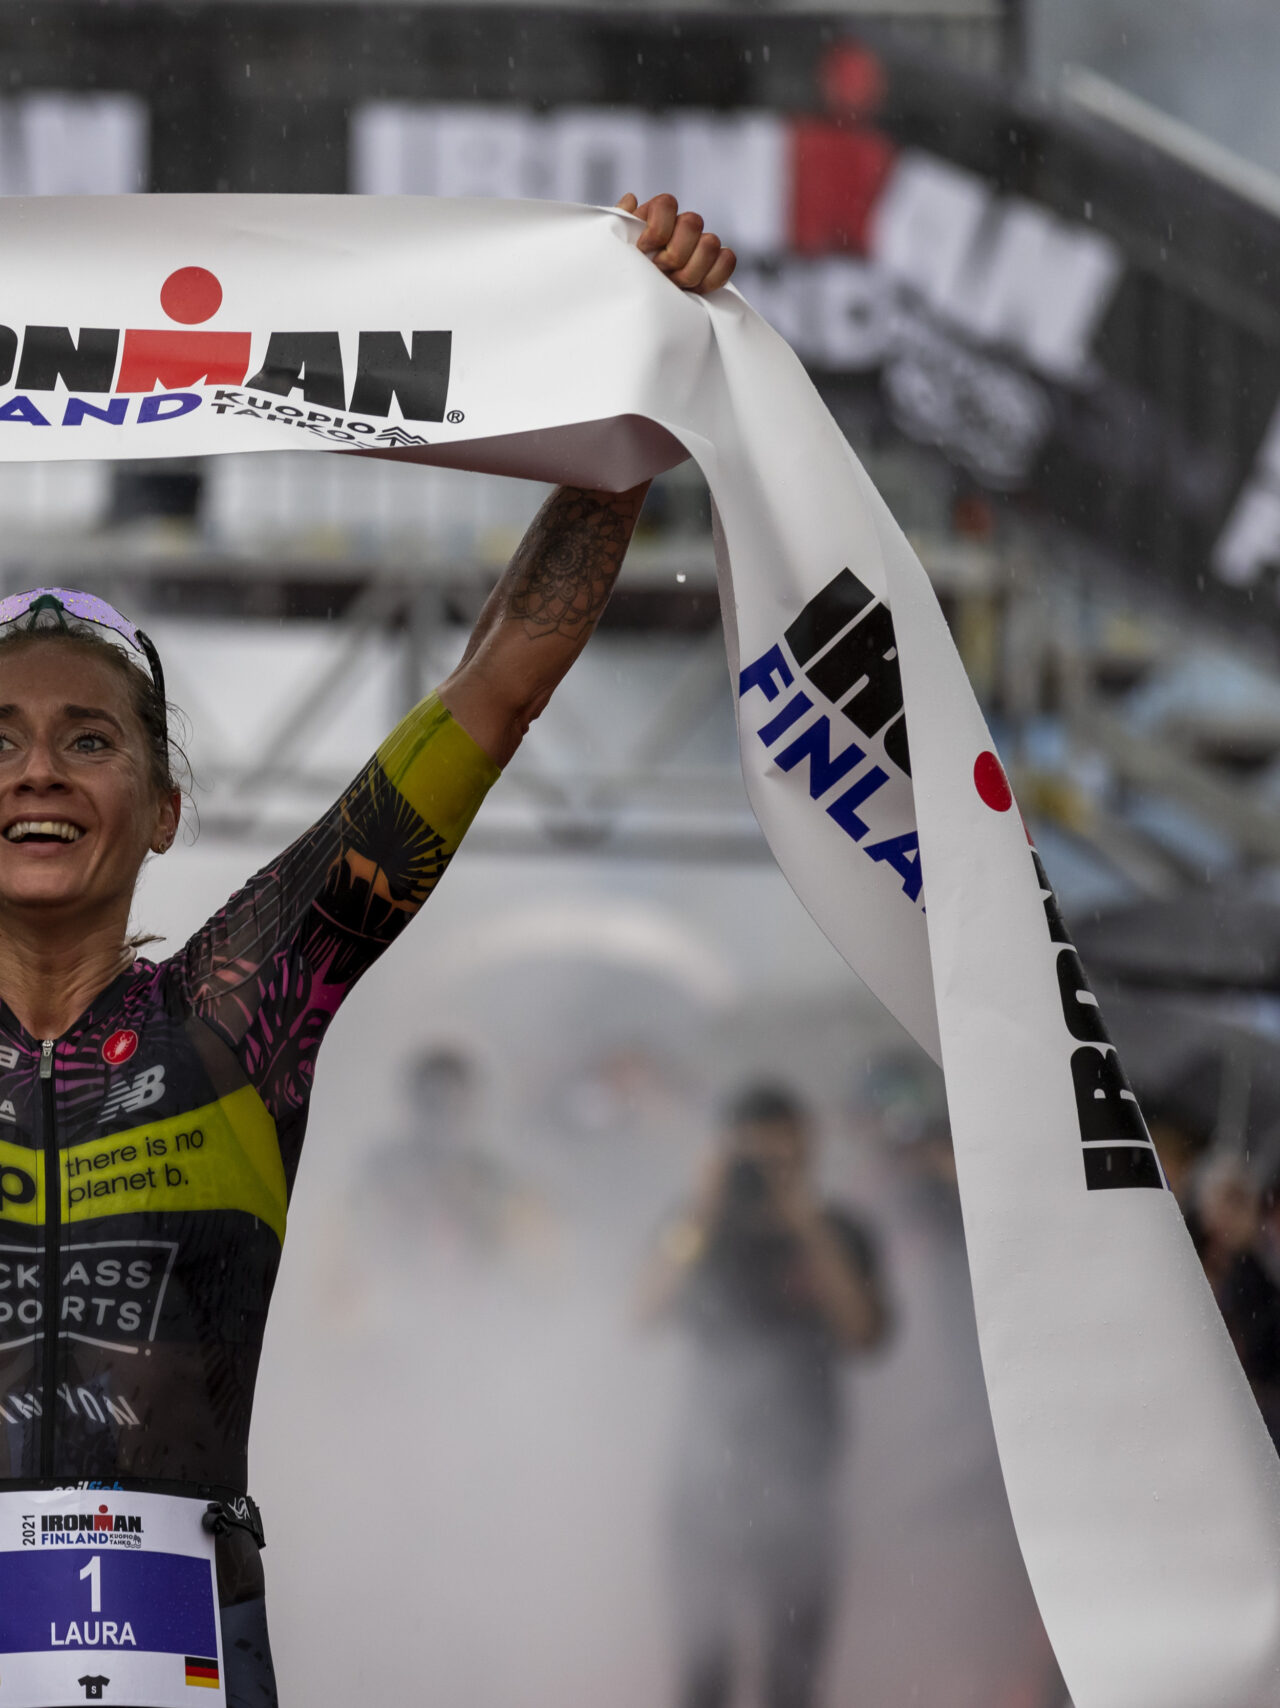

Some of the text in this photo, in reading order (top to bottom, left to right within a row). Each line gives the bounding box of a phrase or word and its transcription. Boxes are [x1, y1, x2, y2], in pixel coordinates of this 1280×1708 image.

[211, 403, 356, 440] TAHKO
[214, 390, 376, 434] KUOPIO
[740, 643, 927, 915] FINLA
[66, 1129, 204, 1178] there is no
[67, 1163, 189, 1208] planet b.
[63, 1260, 152, 1288] ASS
[22, 1514, 35, 1546] 2021
[41, 1514, 142, 1533] IRONMAN
[41, 1532, 109, 1545] FINLAND
[109, 1533, 134, 1541] KUOPIO
[79, 1555, 102, 1613] 1
[50, 1621, 137, 1647] LAURA
[91, 1685, 97, 1695] S
